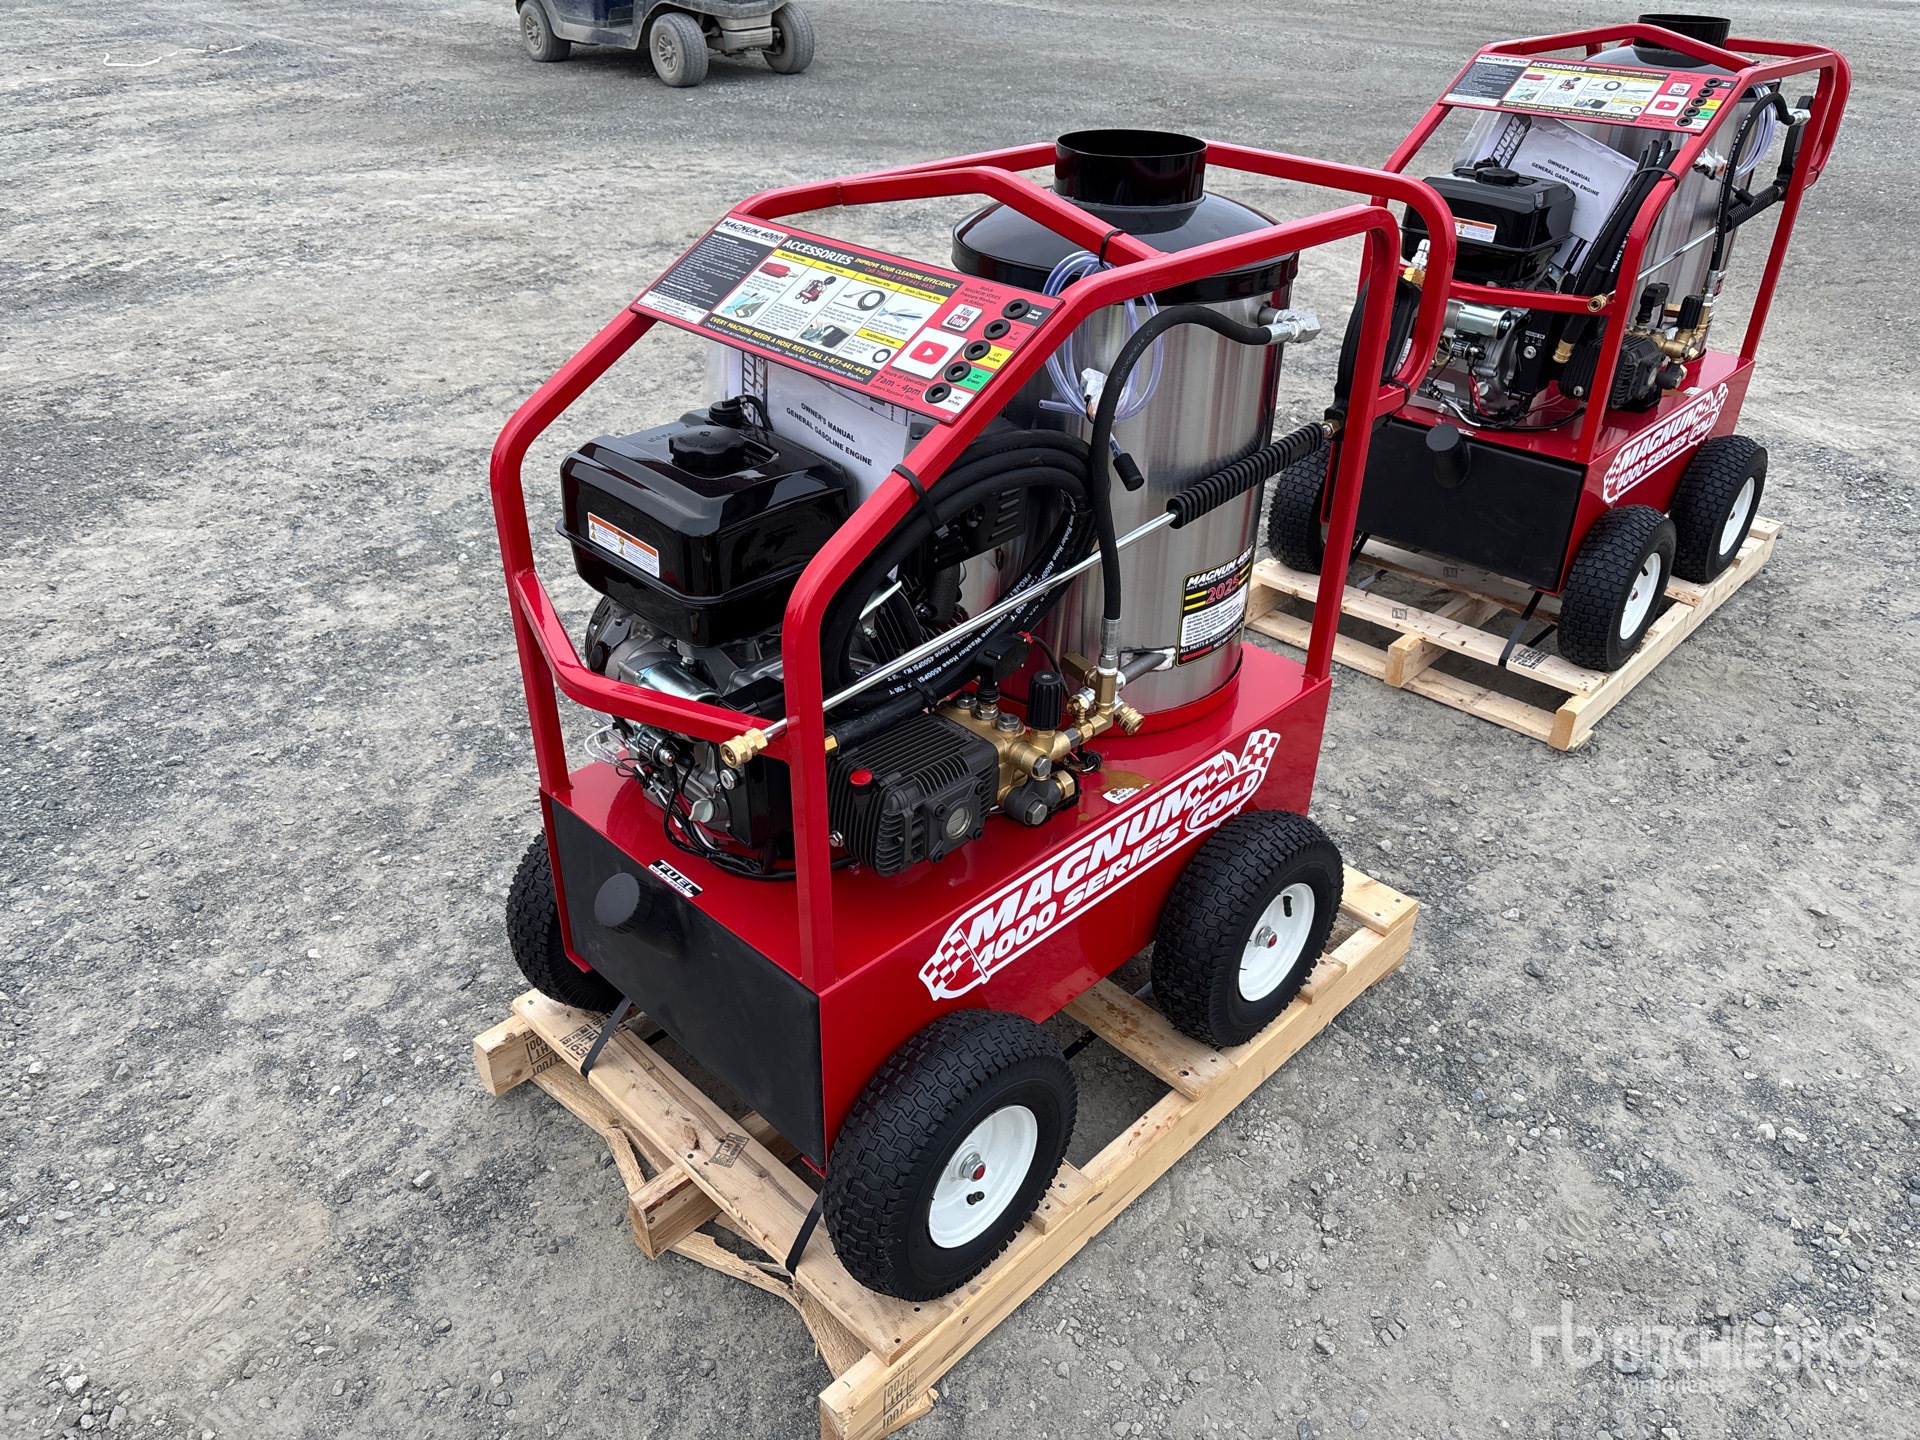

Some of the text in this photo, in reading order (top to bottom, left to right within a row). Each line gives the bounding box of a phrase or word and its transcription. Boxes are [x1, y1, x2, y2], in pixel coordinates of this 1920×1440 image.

[1530, 61, 1588, 71] ACCESSORIES
[1531, 162, 1600, 196] GENERAL GASOLINE ENGINE
[1548, 159, 1591, 182] OWNER'S MANUAL
[721, 220, 762, 234] MAGNUM
[781, 239, 855, 264] ACCESSORIES
[854, 257, 958, 289] IMPROVE YOUR CLEANING EFFICIENCY
[960, 291, 979, 299] Pressure
[948, 315, 970, 326] Tube
[959, 307, 975, 316] You
[709, 316, 728, 325] EVERY
[726, 322, 753, 334] MACHINE
[751, 331, 772, 341] NEEDS
[775, 339, 794, 348] HOSE
[791, 345, 810, 354] REEL!
[807, 350, 825, 359] CALL
[822, 355, 872, 376] 1-877-441-4430
[728, 331, 748, 340] accessory
[798, 356, 818, 365] Magnum
[828, 366, 848, 375] Pressure
[845, 372, 865, 381] Washers
[986, 355, 1002, 363] Yellow
[875, 375, 897, 386] 7am
[900, 384, 923, 396] 4pm
[883, 369, 899, 377] Hours
[902, 376, 929, 388] Operation
[801, 402, 855, 442] OWNER'S MANUAL
[786, 407, 872, 466] GENERAL GASOLINE ENGINE
[1619, 406, 1700, 471] MAGNUM
[1645, 432, 1689, 470] SERIES
[1690, 414, 1717, 439] GOLD
[1187, 559, 1237, 587] MAGNUM
[1206, 573, 1240, 604] 2025
[934, 646, 950, 658] Hose
[959, 637, 982, 657] Washer
[1190, 641, 1205, 650] PARTS
[941, 655, 959, 668] Hose
[917, 667, 942, 683] 4500PSI
[967, 785, 1202, 948] MAGNUM
[967, 785, 1202, 948] MAGNUM
[976, 772, 1256, 971] 4000 SERIES GOLD
[657, 865, 693, 893] FUEL
[535, 1045, 548, 1058] HT
[887, 1374, 905, 1397] 700
[890, 1388, 902, 1407] HT
